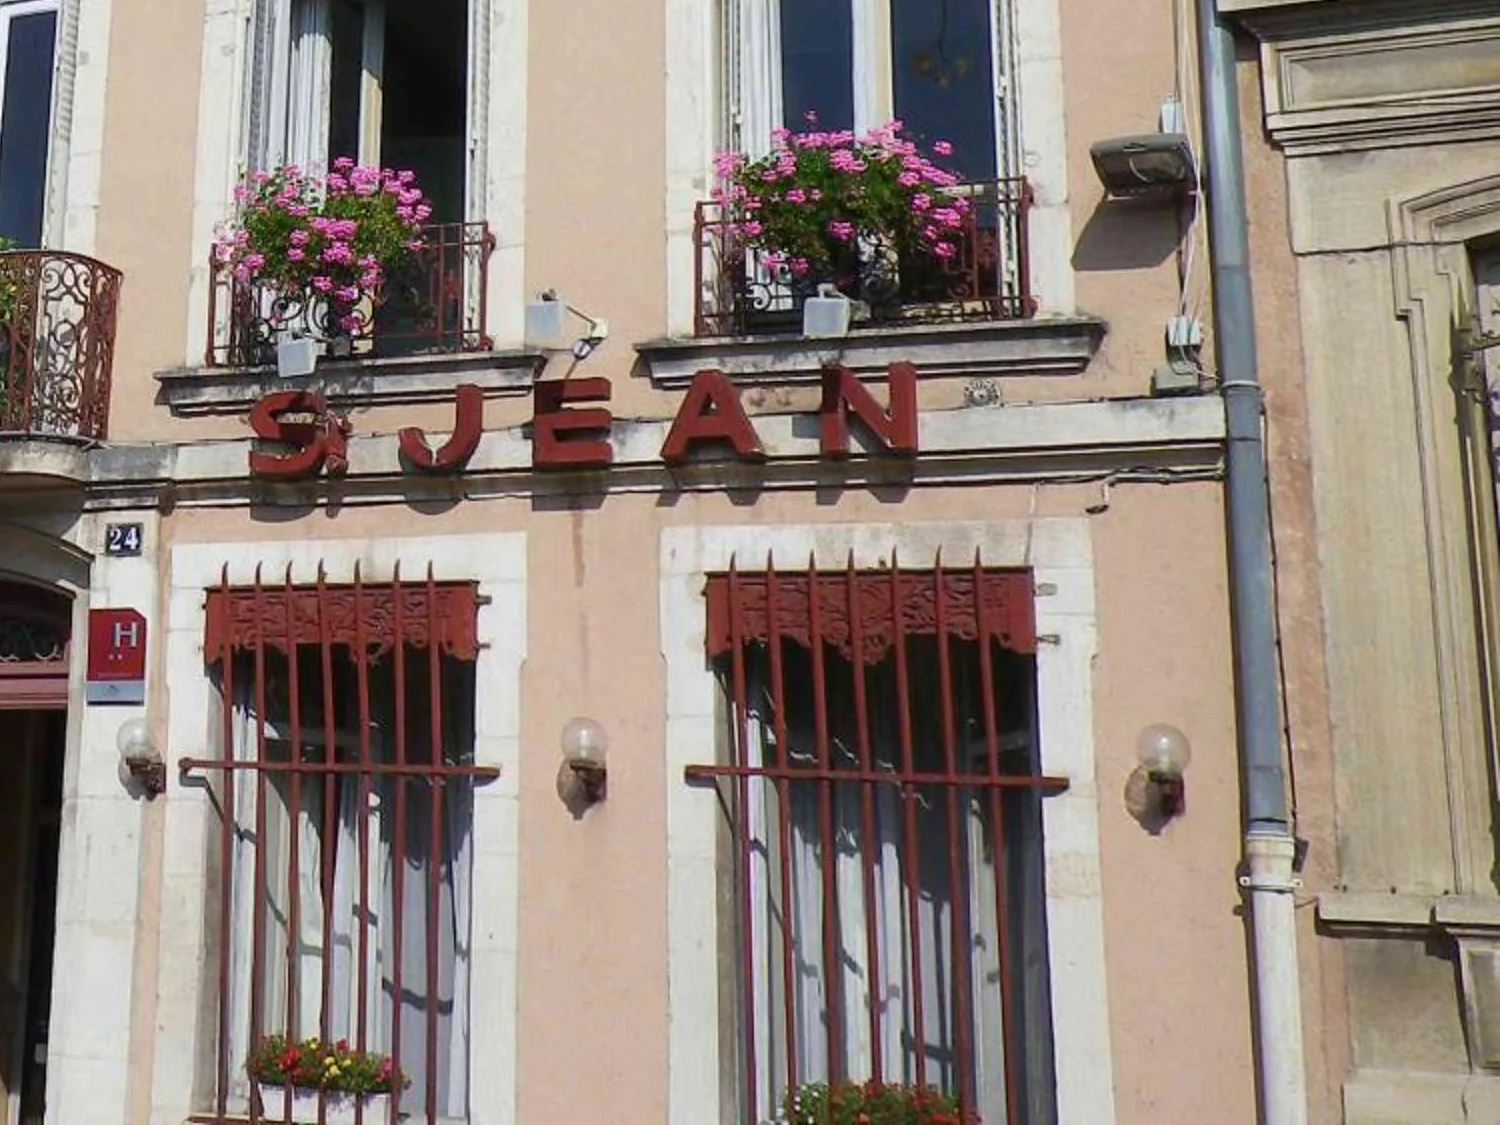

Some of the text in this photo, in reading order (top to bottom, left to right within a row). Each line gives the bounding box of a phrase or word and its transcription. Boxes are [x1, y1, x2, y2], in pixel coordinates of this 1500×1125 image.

[399, 362, 918, 467] JEAN
[109, 527, 139, 550] 24
[114, 622, 138, 648] H
